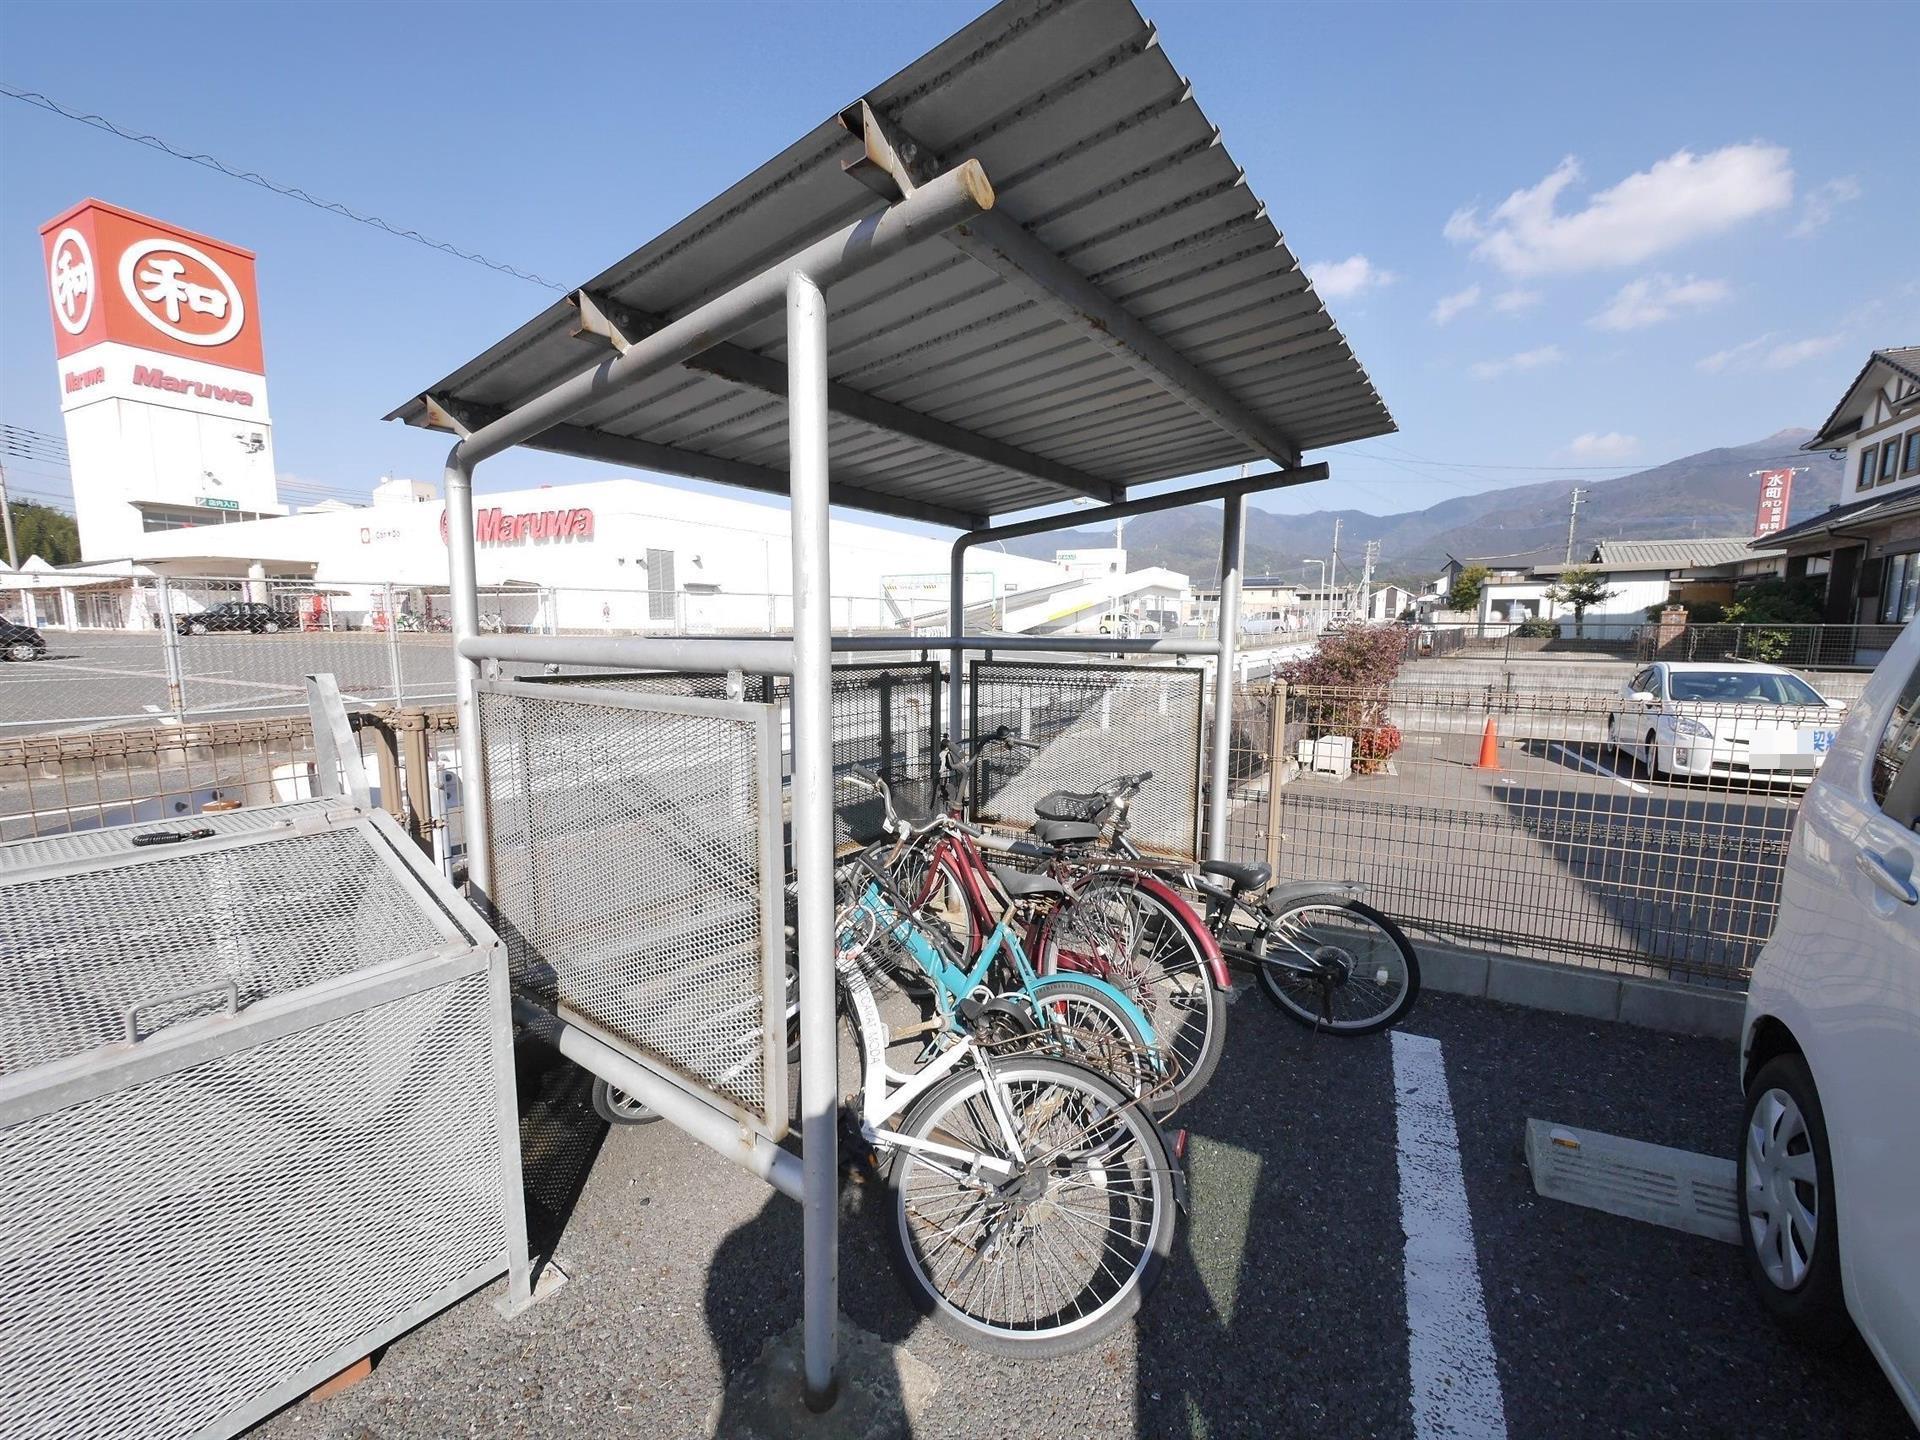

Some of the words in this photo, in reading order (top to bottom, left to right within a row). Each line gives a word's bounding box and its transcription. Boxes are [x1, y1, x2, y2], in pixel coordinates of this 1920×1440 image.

[56, 250, 88, 317] 和
[140, 259, 228, 323] 和
[65, 366, 105, 394] Maruwa
[132, 365, 254, 407] Maruwa
[476, 507, 594, 543] Maruwa
